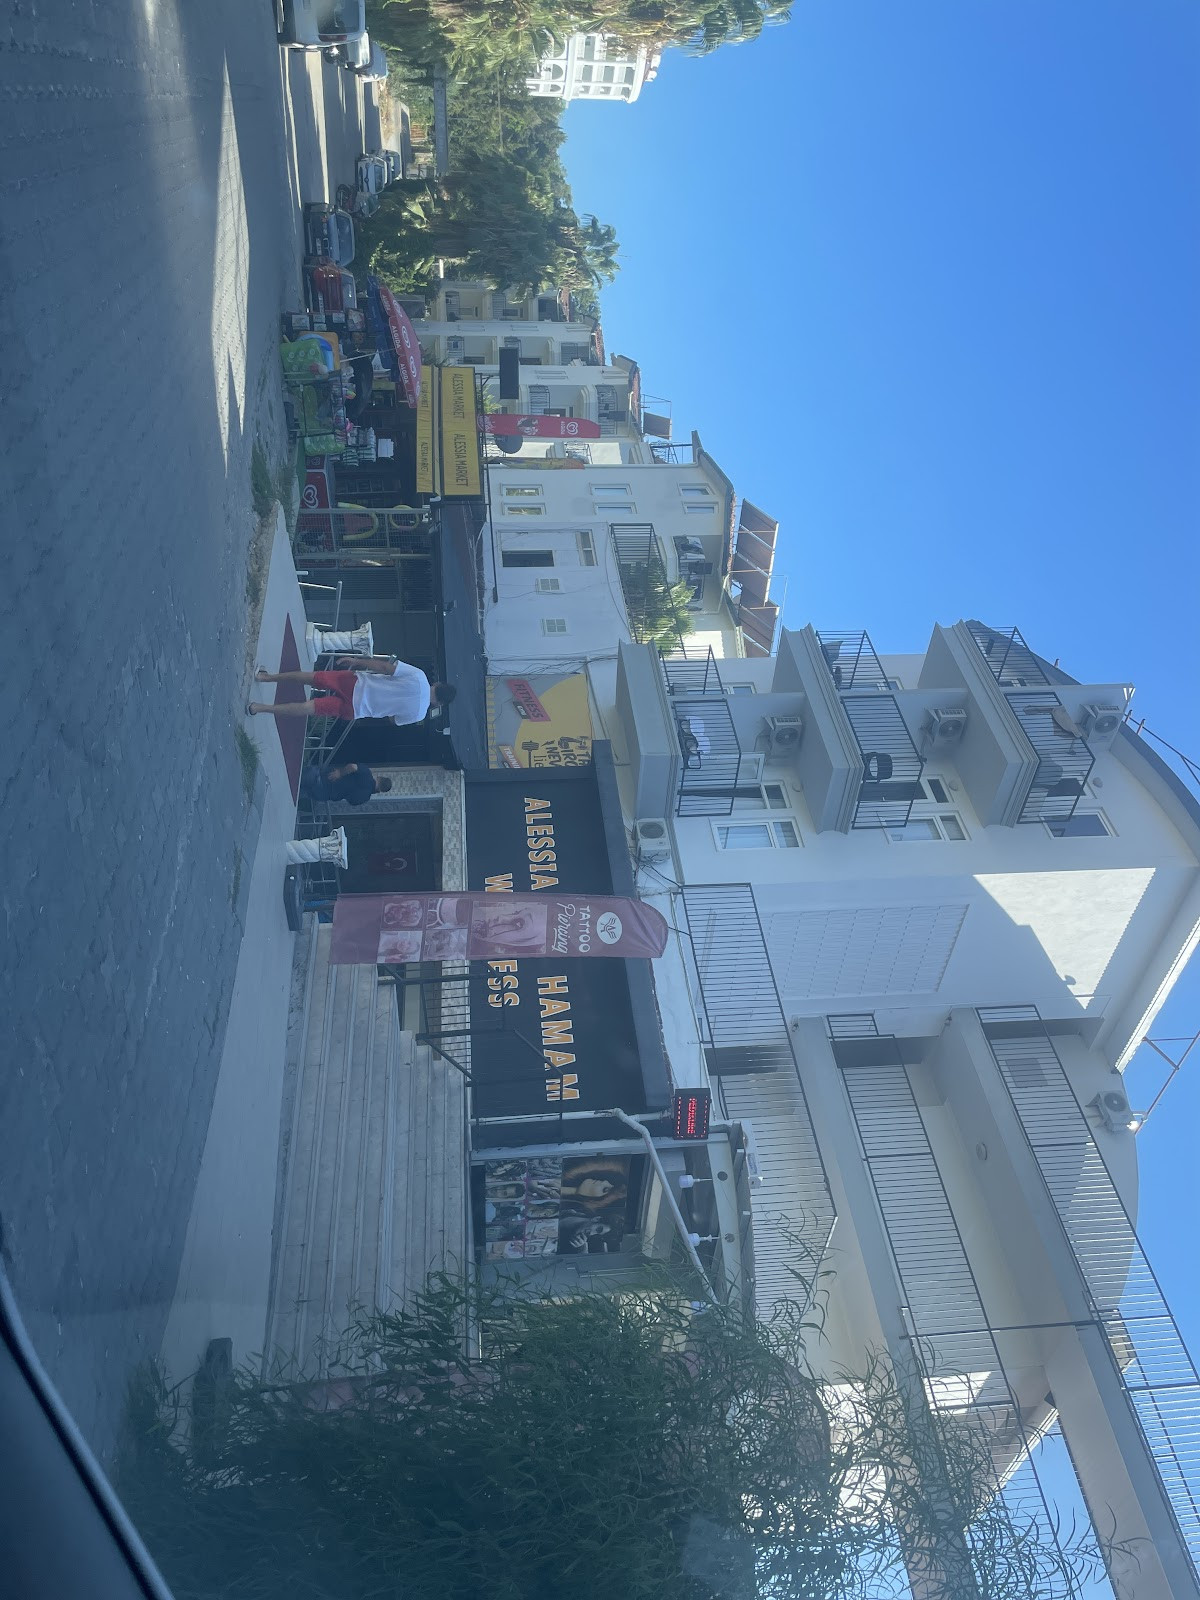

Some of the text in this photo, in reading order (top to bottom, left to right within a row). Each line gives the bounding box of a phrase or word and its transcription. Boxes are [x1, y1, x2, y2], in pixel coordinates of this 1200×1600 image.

[392, 325, 400, 348] ALGIDA
[400, 364, 408, 384] ALGIDA
[452, 374, 464, 418] ALESSIA MARKET
[454, 434, 468, 486] ALESSIA MARKET
[514, 684, 544, 718] FITNESS
[524, 797, 579, 1100] ALESSIA HAMAM
[552, 902, 576, 954] Piercing
[578, 905, 590, 953] TATTOO
